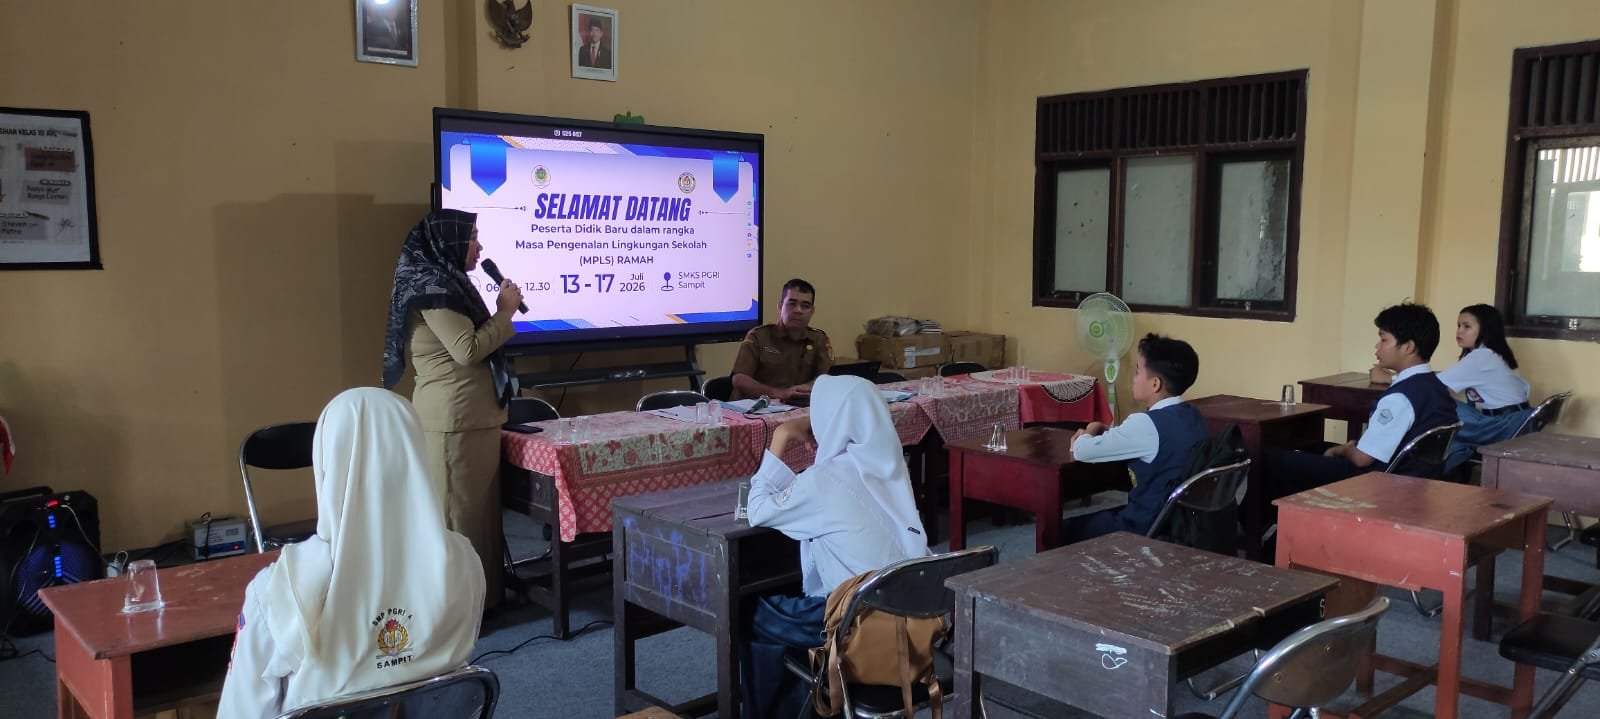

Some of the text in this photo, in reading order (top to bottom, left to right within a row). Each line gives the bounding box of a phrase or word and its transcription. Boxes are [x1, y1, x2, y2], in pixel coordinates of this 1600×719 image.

[18, 128, 37, 137] KELAS
[534, 192, 692, 222] SELAMAT DATANG
[531, 223, 695, 237] Peserta Didik Baru dalam rangka
[515, 240, 707, 251] Masa Pengenalan Lingkungan Sekolah
[579, 255, 654, 267] (MPLS) RAMAH
[630, 272, 644, 281] Juli
[678, 271, 720, 280] SMKS PGRI
[525, 282, 551, 291] 12.30
[560, 274, 581, 294] 13
[594, 273, 615, 294] 17
[619, 282, 646, 292] 2026
[678, 281, 705, 290] Sampit
[372, 612, 385, 627] SMP
[387, 607, 406, 617] PGRI
[376, 655, 413, 669] SAMPIT
